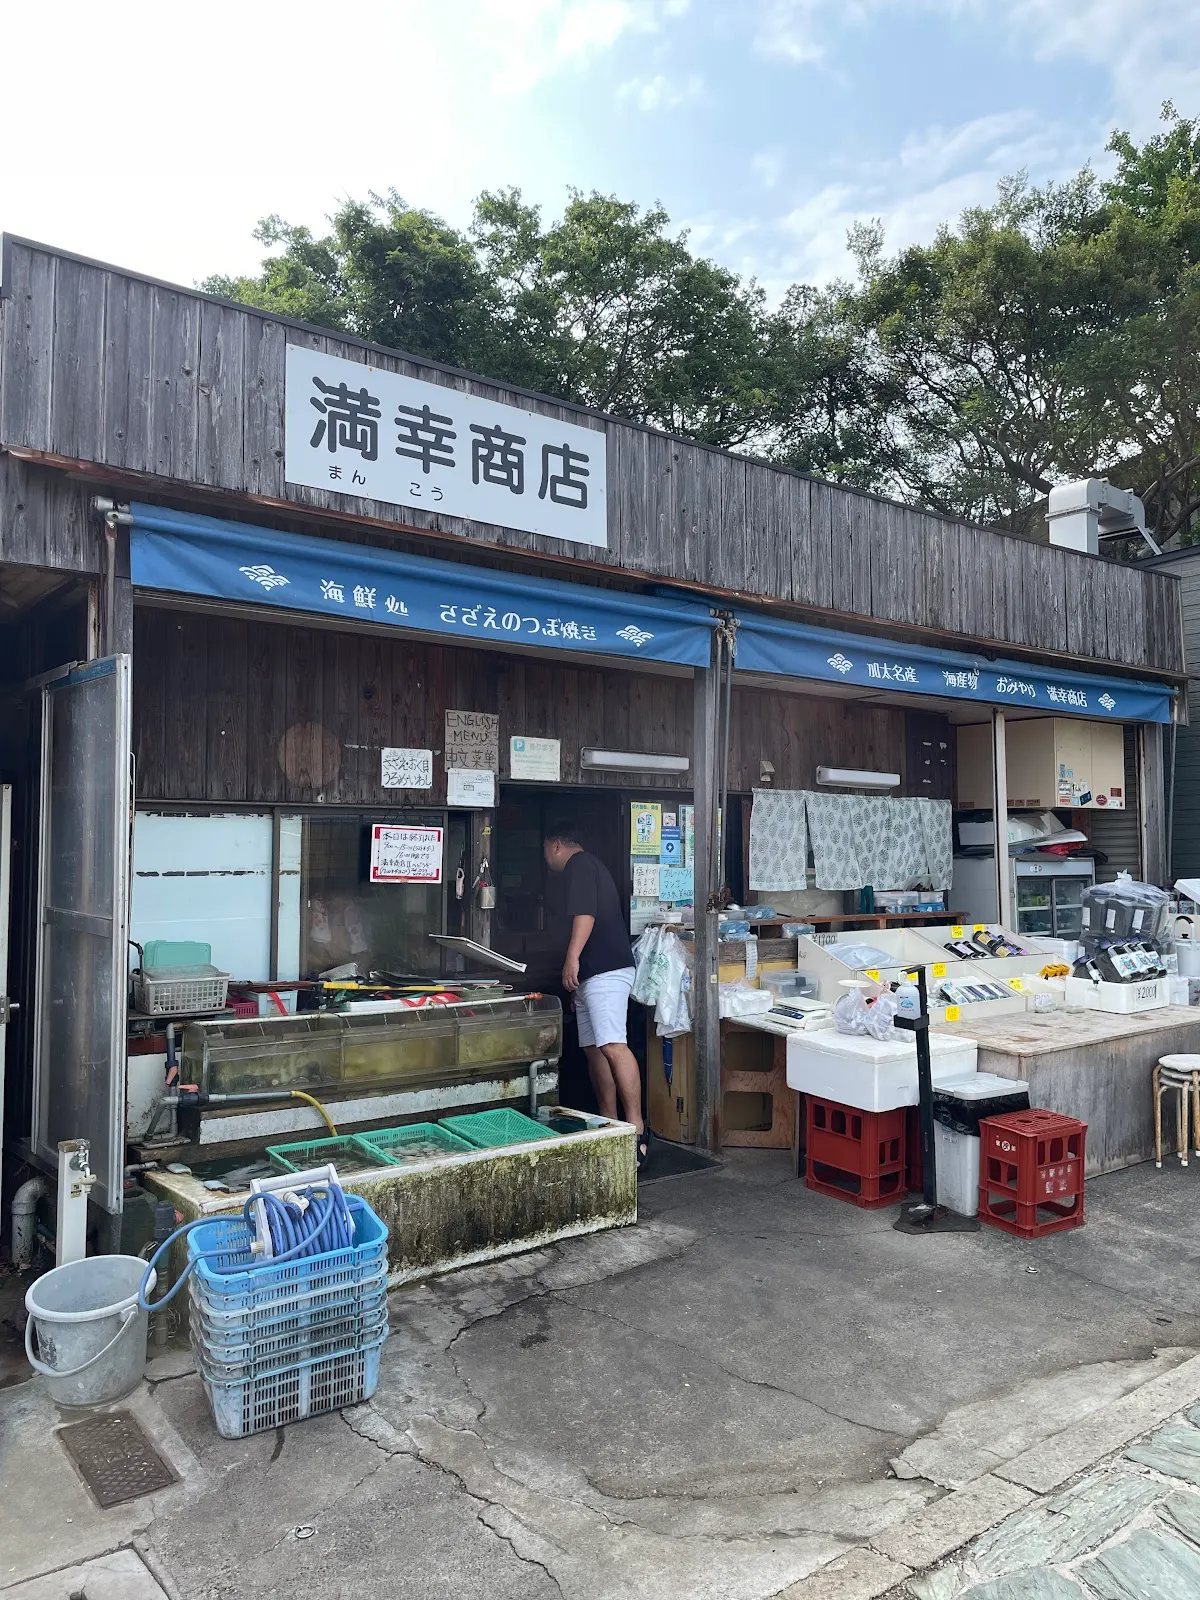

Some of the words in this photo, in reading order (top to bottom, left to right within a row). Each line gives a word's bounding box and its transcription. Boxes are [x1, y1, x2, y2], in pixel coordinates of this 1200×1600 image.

[309, 376, 590, 509] 満幸商店
[328, 465, 366, 485] まん
[409, 482, 444, 501] こう
[320, 579, 409, 616] 海鮮処
[439, 604, 598, 641] さざえのつぼ焼き
[866, 662, 920, 683] 加太名産
[942, 669, 979, 690] 海産物
[1047, 685, 1088, 707] 満幸商店
[446, 711, 498, 730] ENGLISH
[453, 729, 488, 742] MENU
